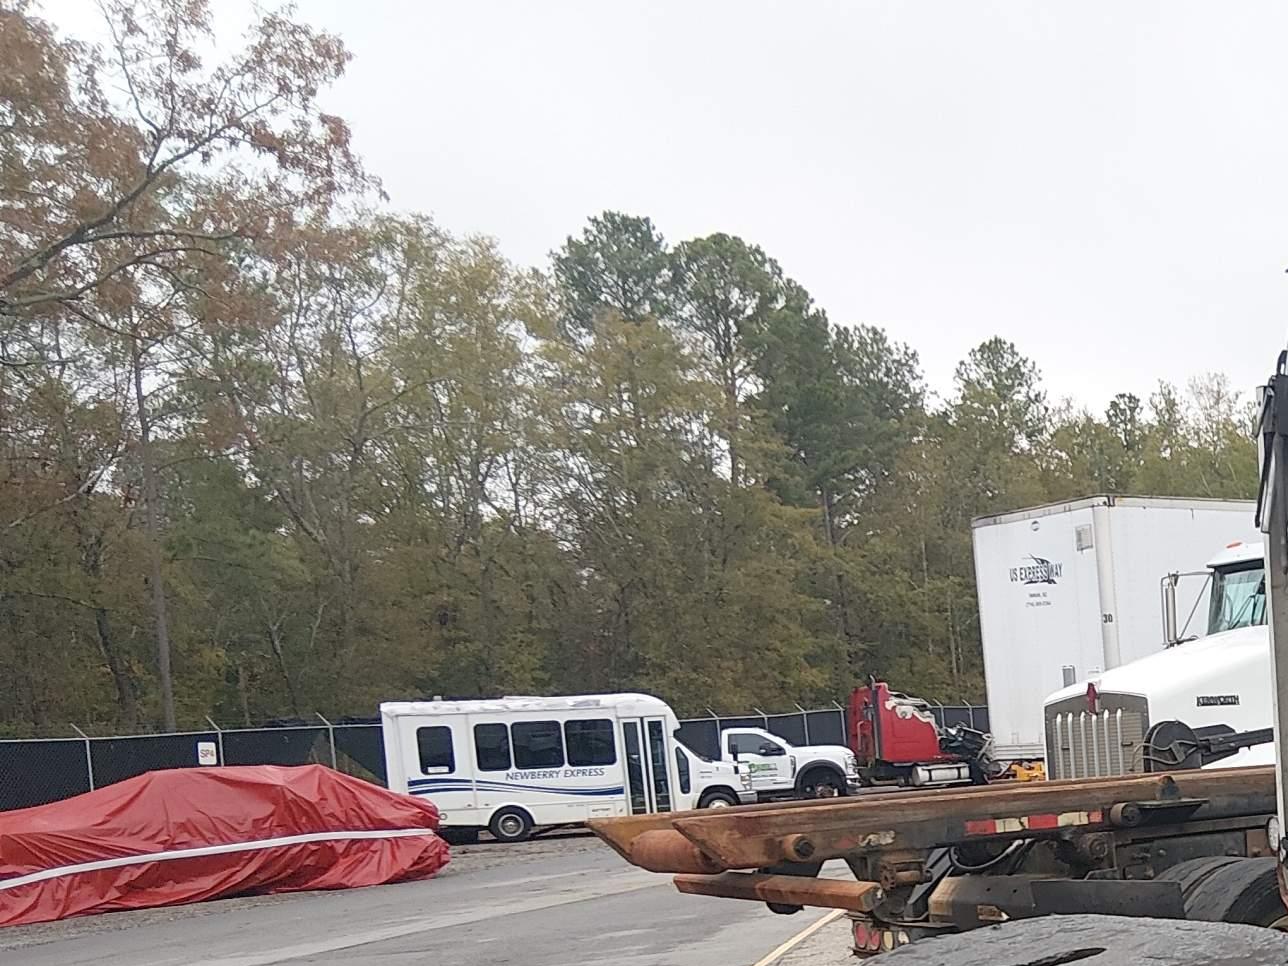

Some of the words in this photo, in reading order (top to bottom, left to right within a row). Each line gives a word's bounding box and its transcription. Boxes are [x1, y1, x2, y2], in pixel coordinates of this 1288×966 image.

[1009, 568, 1018, 582] US
[505, 769, 560, 781] NEWBERRY
[563, 767, 605, 778] EXPRESS
